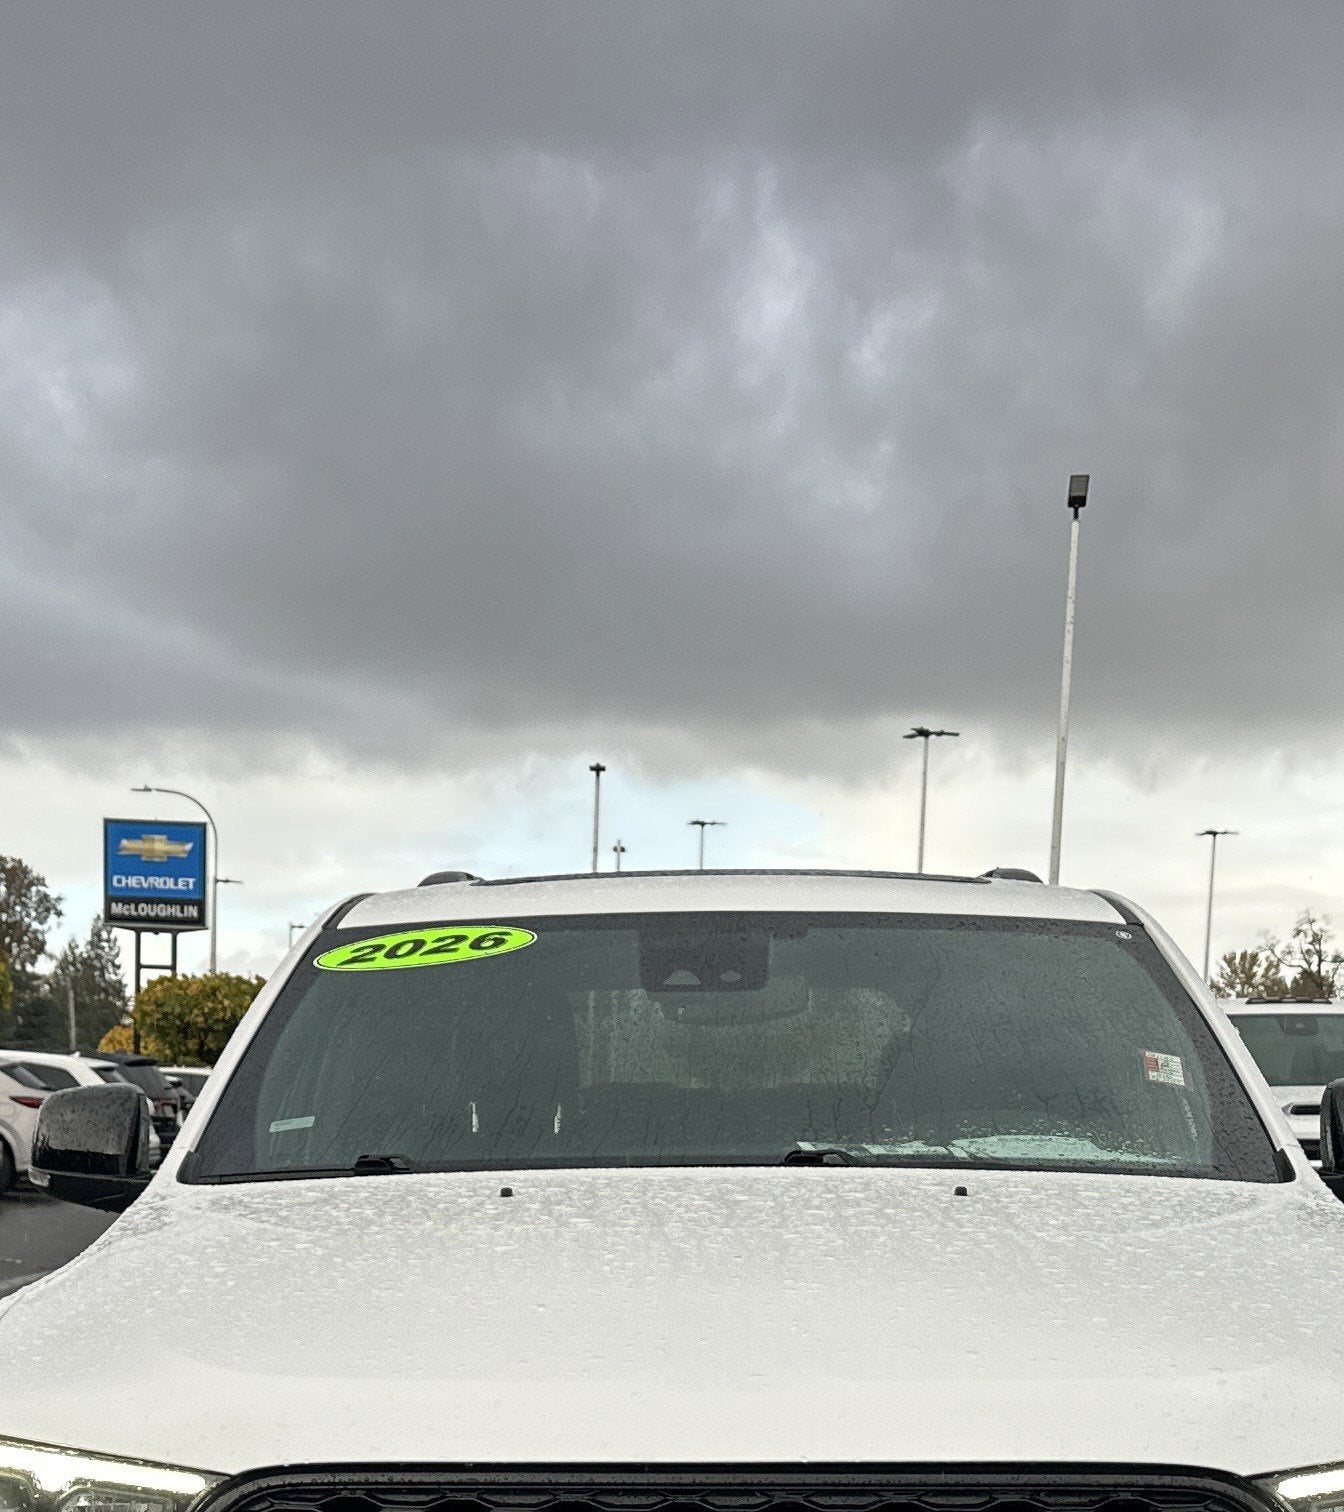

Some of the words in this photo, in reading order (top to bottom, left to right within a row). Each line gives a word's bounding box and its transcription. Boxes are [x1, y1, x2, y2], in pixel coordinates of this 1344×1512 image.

[112, 874, 196, 890] CHEVROLET
[110, 902, 199, 918] McLOUGHLIN
[336, 931, 513, 967] 2026
